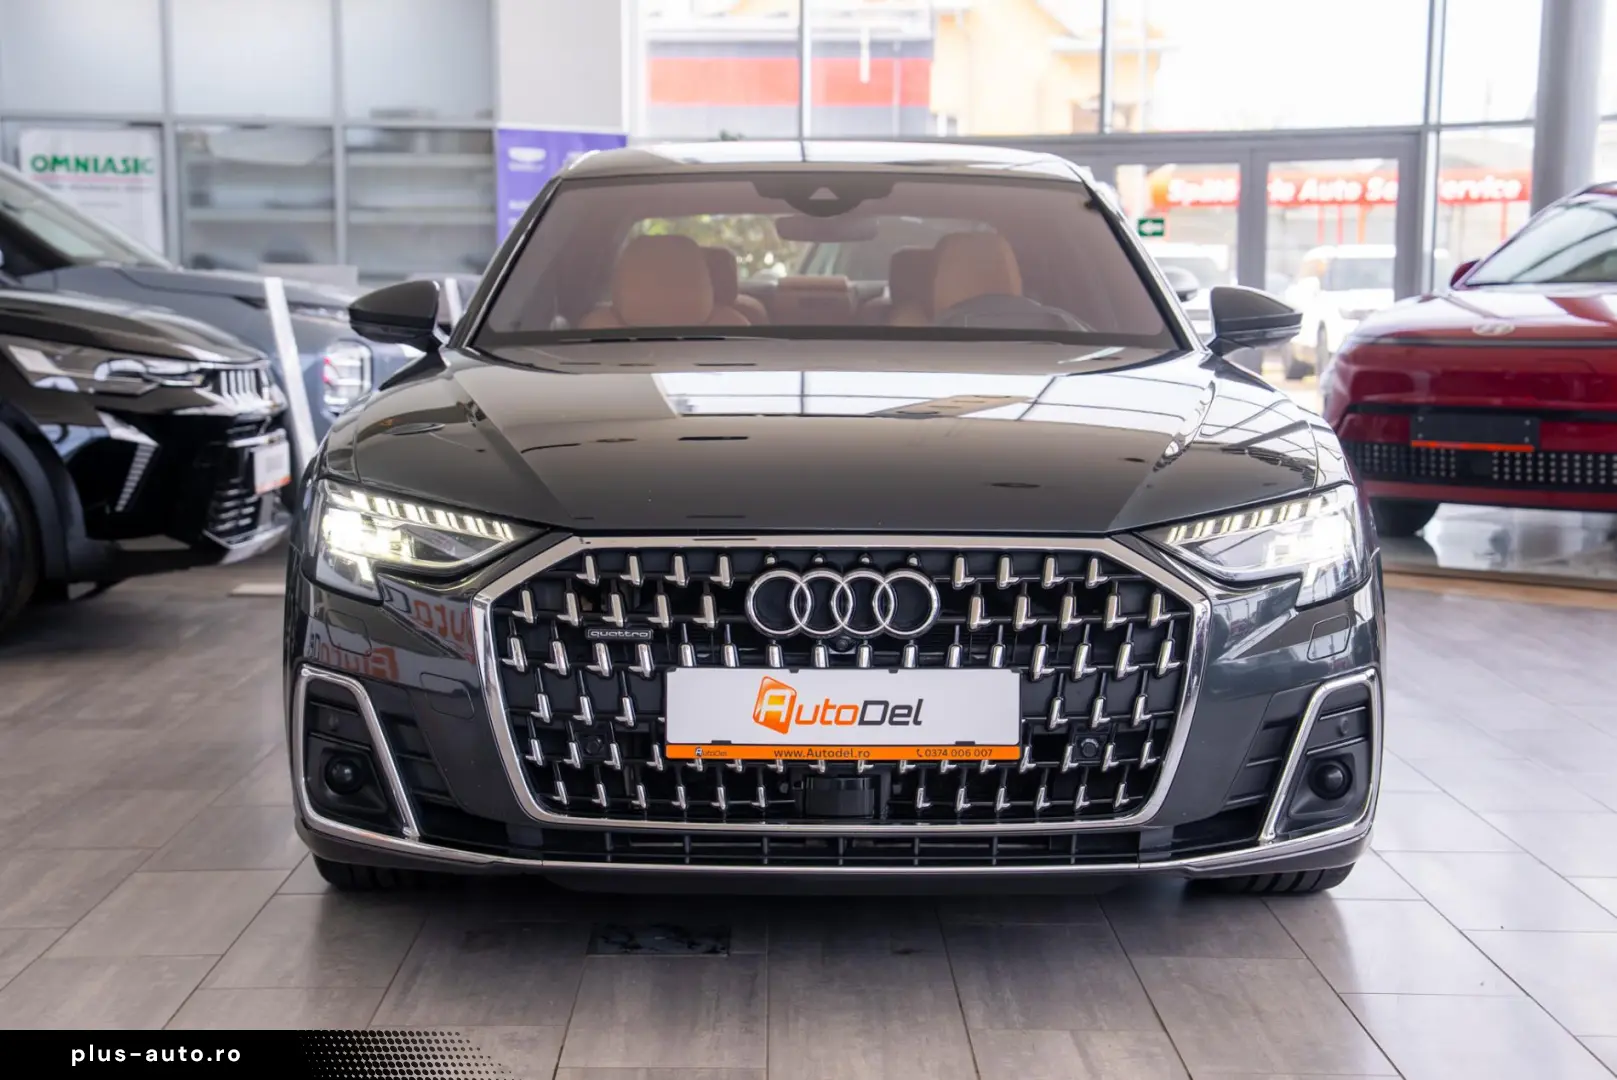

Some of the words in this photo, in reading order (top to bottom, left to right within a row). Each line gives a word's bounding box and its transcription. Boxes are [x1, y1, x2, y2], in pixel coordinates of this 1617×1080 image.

[1297, 178, 1361, 202] Auto
[1437, 174, 1522, 201] ervice
[590, 630, 649, 638] quattro
[753, 676, 925, 735] AutoDel
[773, 748, 871, 758] www.Autodel.ro
[924, 749, 948, 757] 0374
[951, 749, 971, 757] 006
[974, 749, 993, 757] 007
